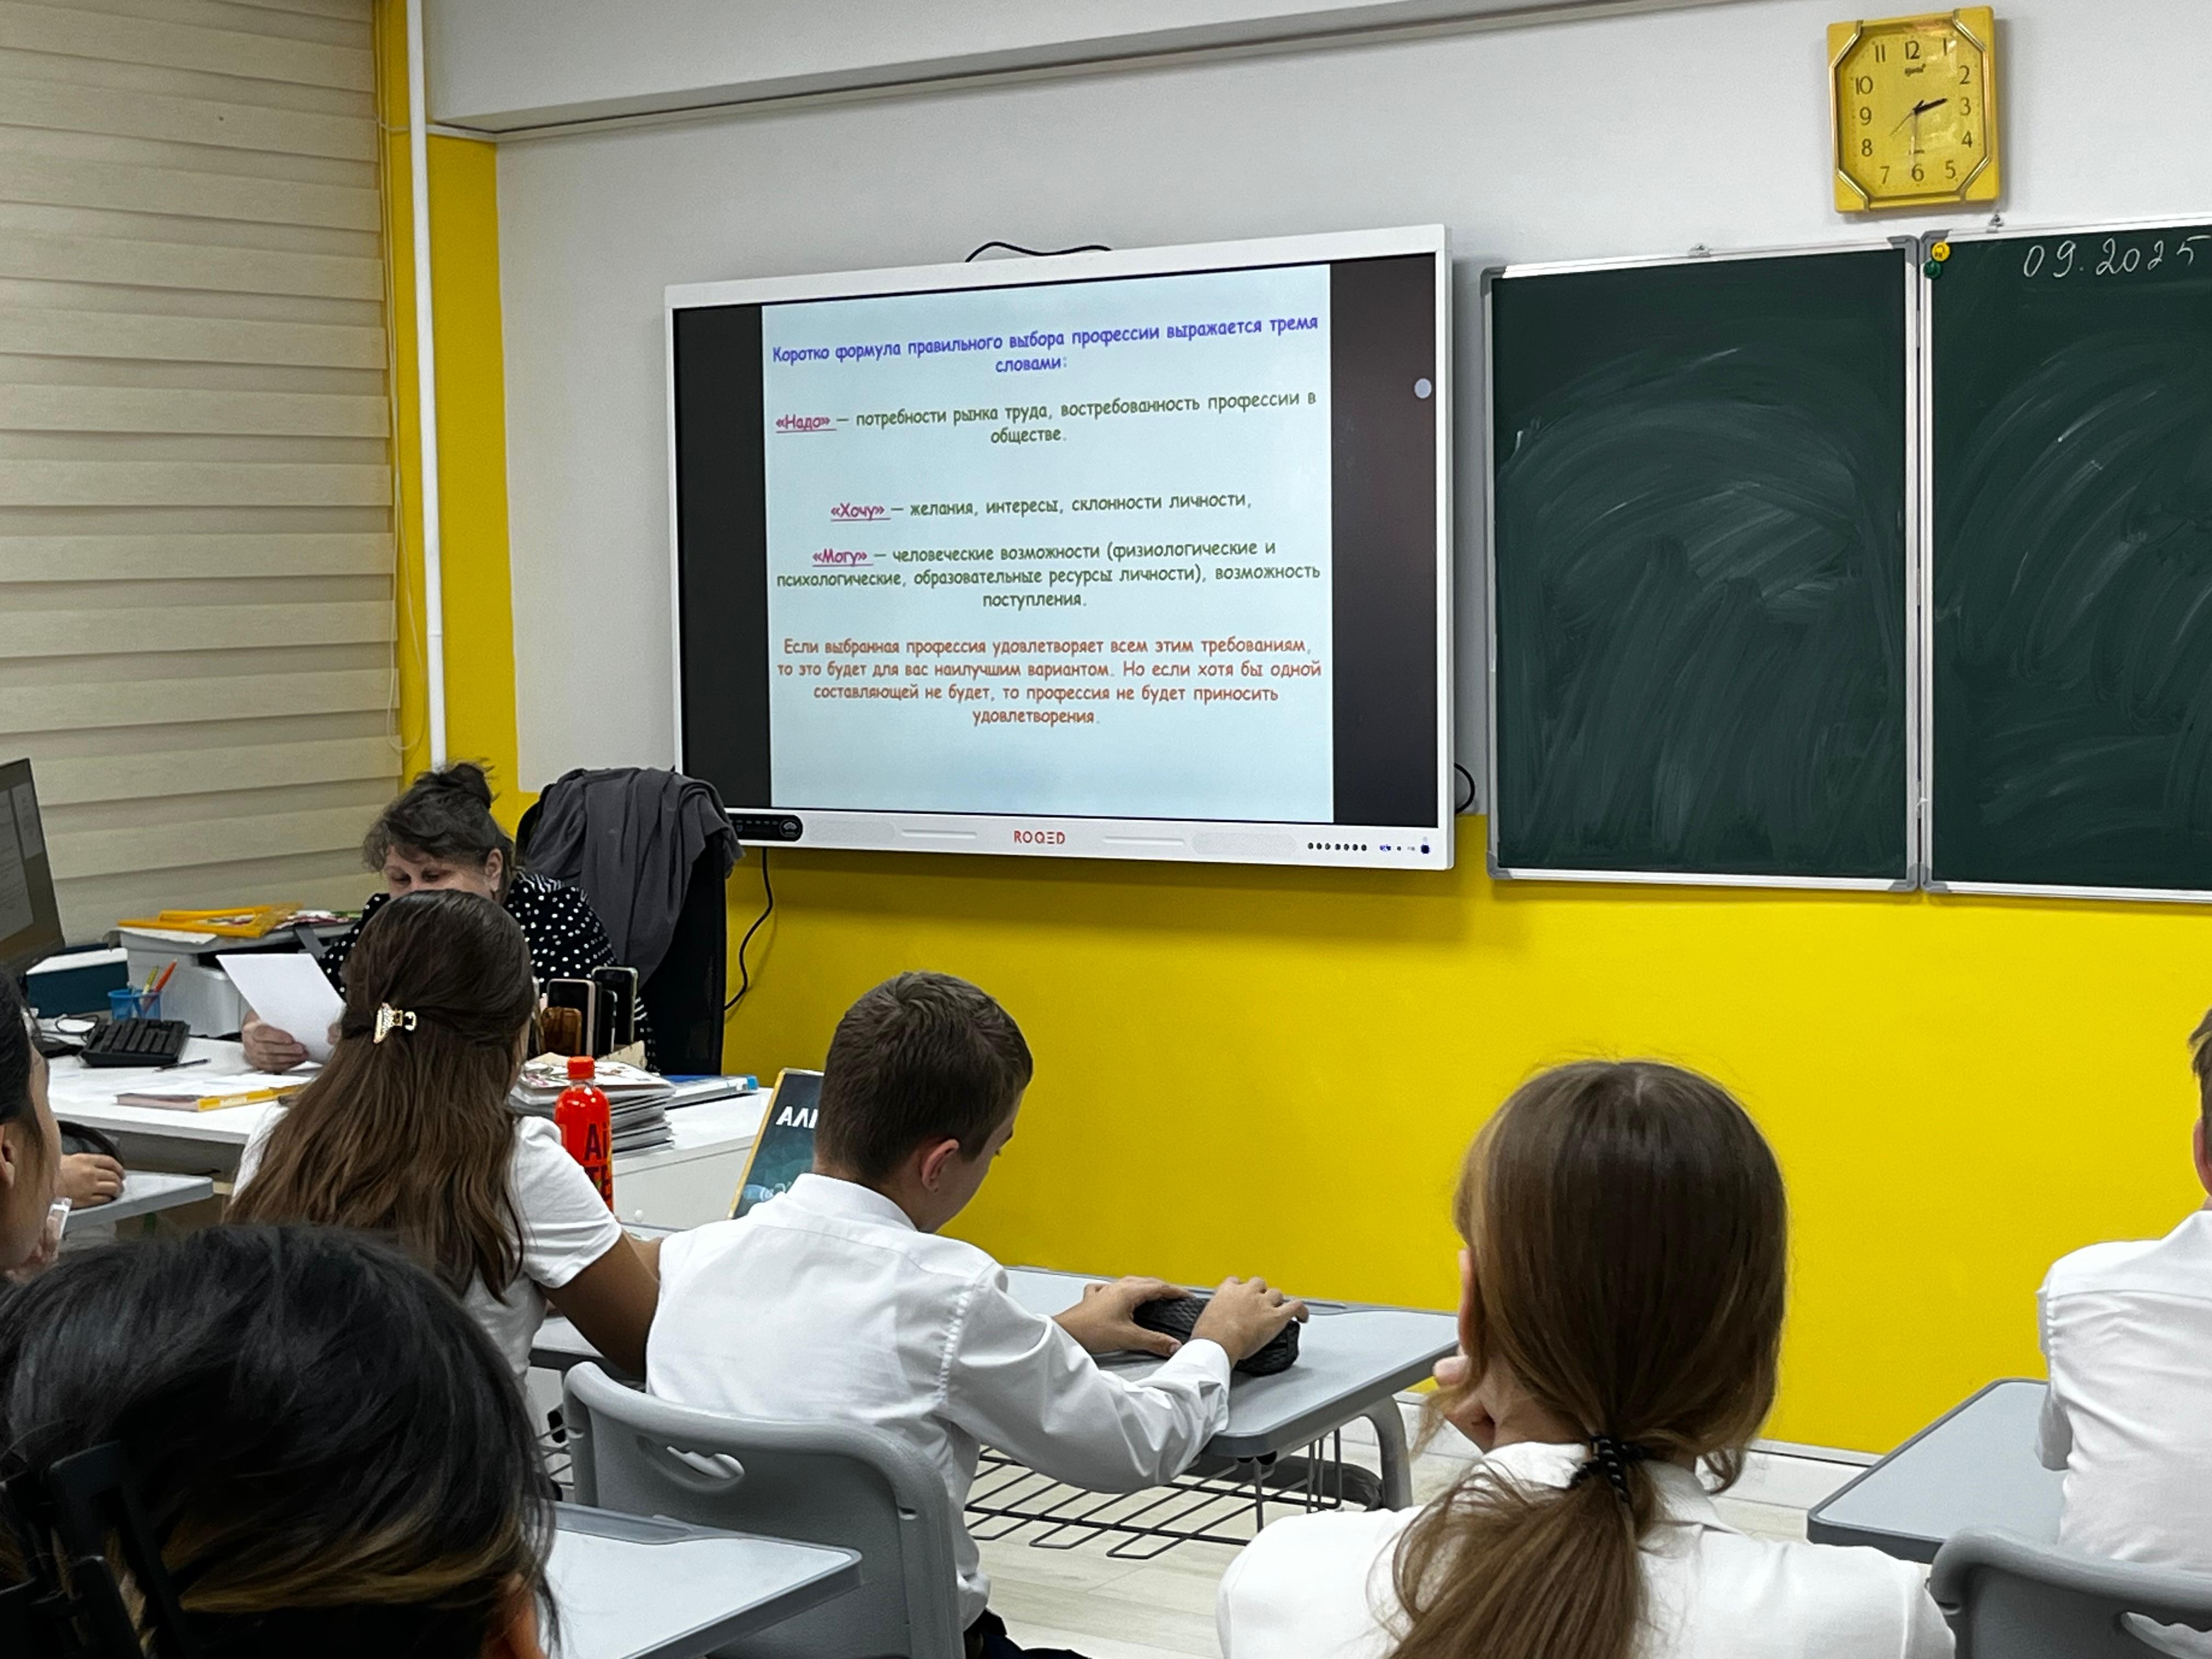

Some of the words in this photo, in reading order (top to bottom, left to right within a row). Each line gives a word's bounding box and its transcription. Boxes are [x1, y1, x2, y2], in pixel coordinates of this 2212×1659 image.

[1874, 44, 1886, 63] 11
[1905, 40, 1920, 60] 12
[1943, 38, 1948, 56] 1
[1959, 66, 1970, 84] 2
[1855, 76, 1873, 95] 10
[1960, 97, 1971, 116] 3
[1859, 108, 1872, 125] 9
[1861, 139, 1873, 157] 8
[1961, 130, 1973, 148] 4
[1880, 166, 1890, 185] 7
[1911, 163, 1924, 182] 6
[1945, 160, 1956, 179] 5
[773, 347, 830, 366] Коротко
[836, 344, 901, 363] формула
[909, 337, 1003, 358] правильного
[1009, 330, 1064, 351] выбора
[1072, 327, 1159, 349] профессии
[1167, 320, 1262, 341] выражается
[1269, 317, 1318, 336] тремя
[996, 357, 1066, 373] словами:
[776, 414, 832, 433] «Надо»
[856, 408, 946, 430] потребности
[953, 408, 998, 426] рынка
[1005, 406, 1052, 424] труда,
[1061, 397, 1200, 420] востребованность
[1208, 393, 1299, 414] профессии
[1308, 392, 1316, 404] в
[991, 427, 1066, 444] обществе.
[831, 503, 884, 521] «Хочу»
[910, 503, 978, 516] желания,
[986, 500, 1063, 518] интересы,
[1072, 497, 1161, 511] склонности
[1169, 494, 1251, 508] личности,
[812, 549, 867, 567] «Могу»
[893, 549, 994, 562] человеческие
[1001, 546, 1100, 560] возможности
[1107, 541, 1257, 562] (физиологические
[1265, 543, 1276, 554] и
[777, 574, 906, 587] психологические,
[914, 569, 1042, 589] образовательные
[1049, 569, 1113, 588] ресурсы
[1119, 563, 1206, 584] личности),
[1216, 566, 1321, 579] возможность
[983, 594, 1087, 611] поступления.
[785, 639, 819, 654] Если
[825, 638, 899, 657] выбранная
[906, 642, 986, 658] профессия
[992, 641, 1104, 657] удовлетворяет
[1111, 641, 1148, 653] всем
[1155, 641, 1194, 652] этим
[1201, 636, 1310, 657] требованиям,
[777, 665, 792, 675] то
[799, 665, 821, 675] это
[827, 661, 866, 680] будет
[872, 665, 898, 678] для
[905, 665, 928, 675] вас
[935, 665, 1020, 680] наилучшим
[1028, 665, 1114, 681] вариантом.
[1124, 661, 1144, 676] Но
[1152, 665, 1190, 676] если
[1198, 665, 1233, 676] хотя
[1241, 660, 1263, 676] бы
[1271, 660, 1321, 678] одной
[814, 684, 918, 701] составляющей
[926, 688, 941, 698] не
[949, 684, 994, 704] будет,
[1002, 689, 1019, 699] то
[1026, 689, 1109, 704] профессия
[1117, 689, 1135, 699] не
[1142, 685, 1186, 705] будет
[1194, 689, 1278, 706] приносить
[973, 711, 1099, 727] удовлетворения.
[1014, 830, 1065, 844] ROQED
